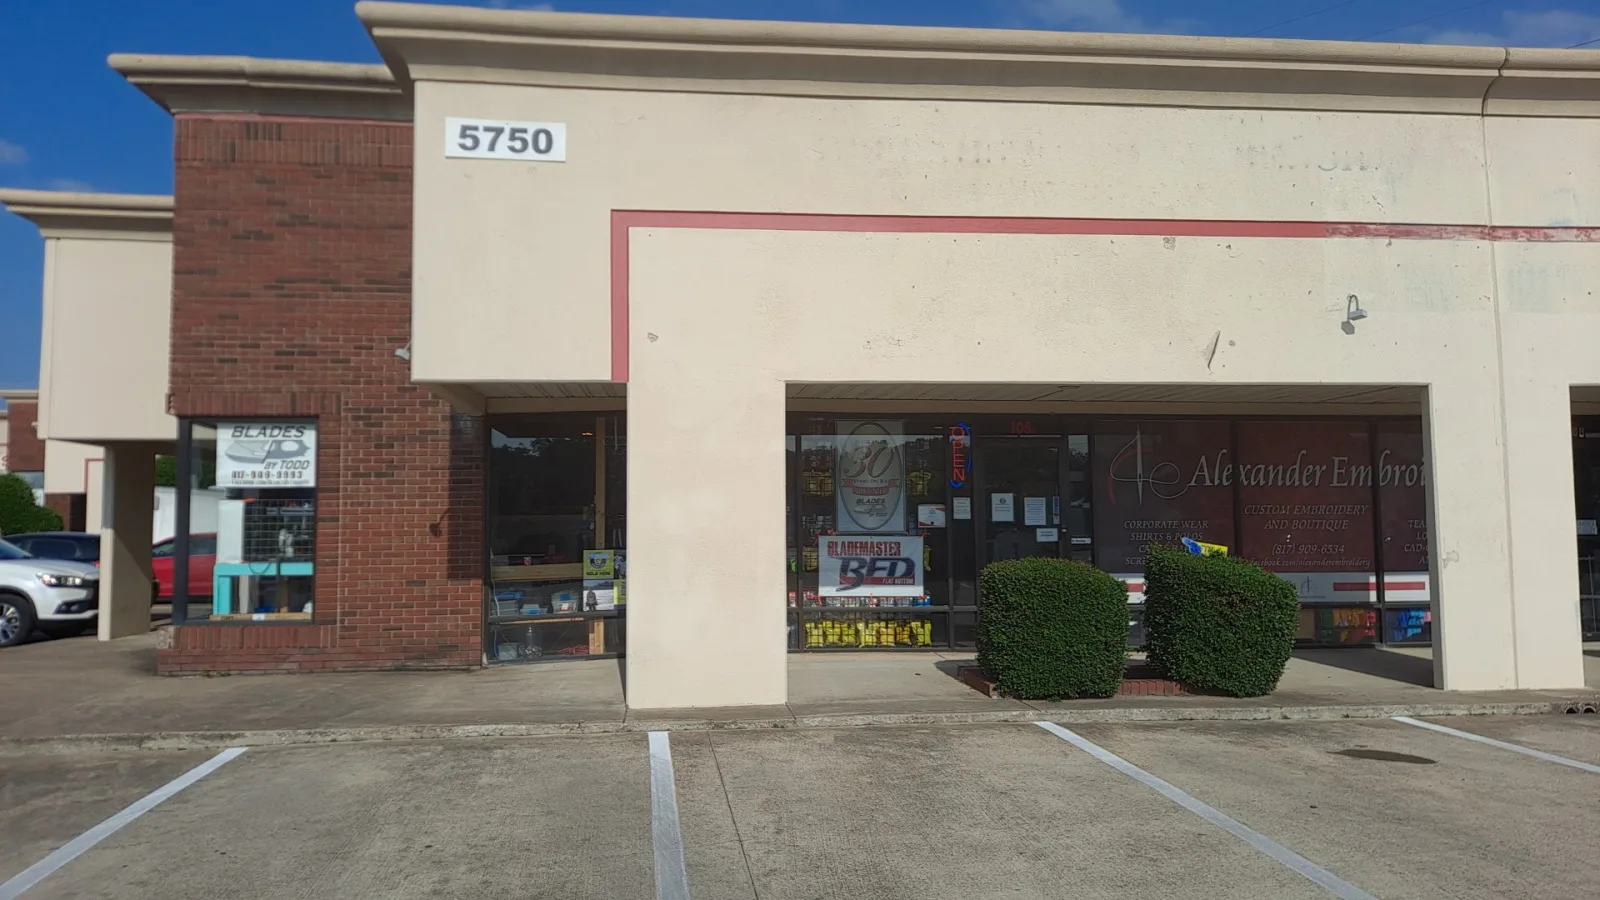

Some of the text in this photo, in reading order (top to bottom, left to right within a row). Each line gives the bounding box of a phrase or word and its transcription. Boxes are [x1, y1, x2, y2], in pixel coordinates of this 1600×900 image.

[458, 124, 553, 155] 5750
[231, 425, 307, 438] BLADES
[951, 426, 966, 482] OPEN
[264, 460, 310, 470] BY TODD
[1188, 449, 1426, 487] Alexander Embroi
[1244, 505, 1368, 515] CUSTOM EMBROIDERY
[1124, 520, 1209, 529] CORPORATE WEAR
[1264, 520, 1349, 531] AND BOUTIQUE
[1408, 520, 1426, 528] TEA
[1130, 532, 1163, 541] SHIRTS
[827, 541, 901, 556] BLADEMASTER
[1272, 543, 1345, 555] (817) 909-6534
